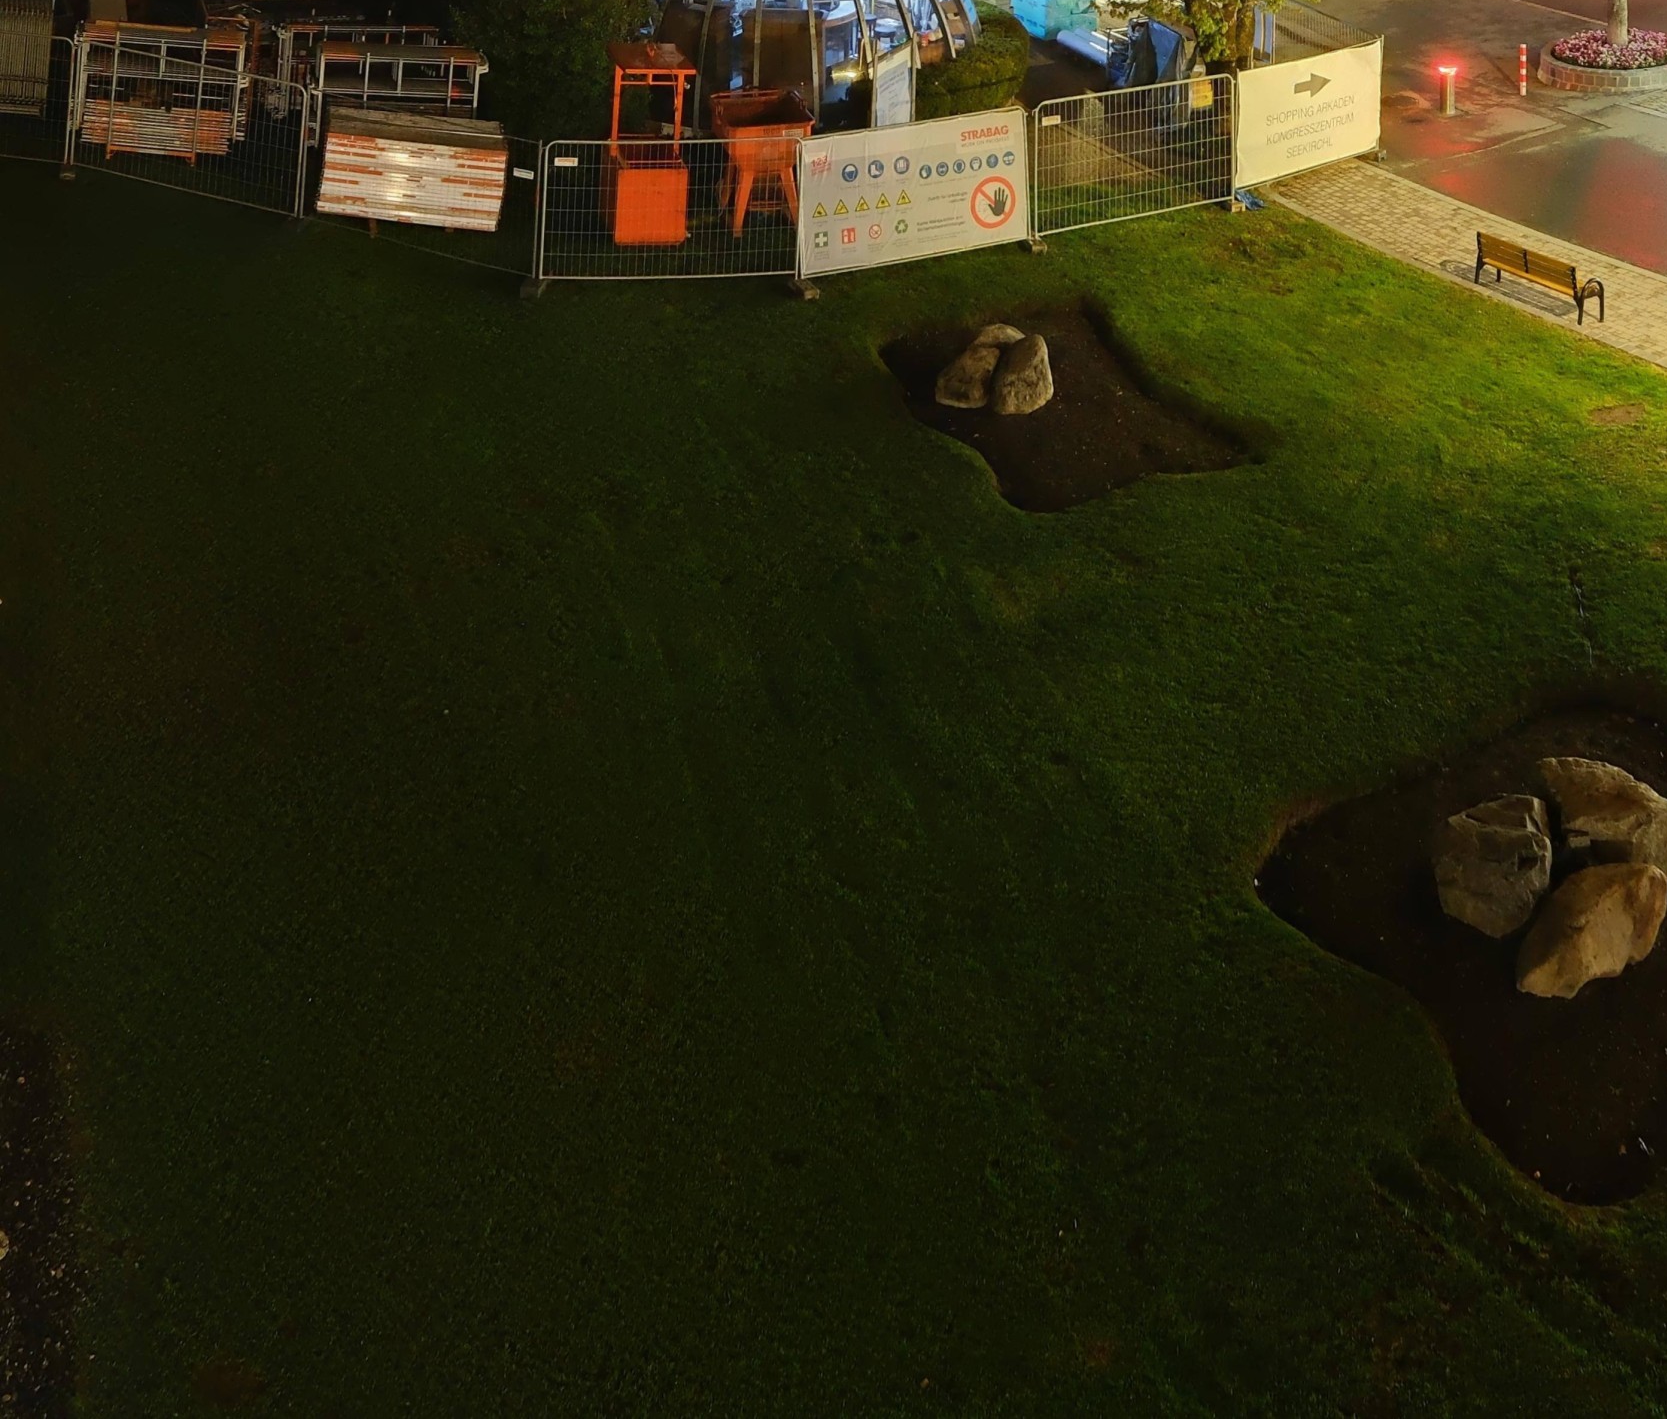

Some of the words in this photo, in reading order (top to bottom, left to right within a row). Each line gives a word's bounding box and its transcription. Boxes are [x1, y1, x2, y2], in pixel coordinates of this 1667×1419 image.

[1265, 106, 1314, 127] SHOPPING
[1316, 95, 1355, 114] ARKADEN
[961, 125, 1009, 141] STRABAG
[1266, 112, 1355, 145] KONGRESSZENTRUM
[1286, 137, 1333, 159] SEEKIRCHL
